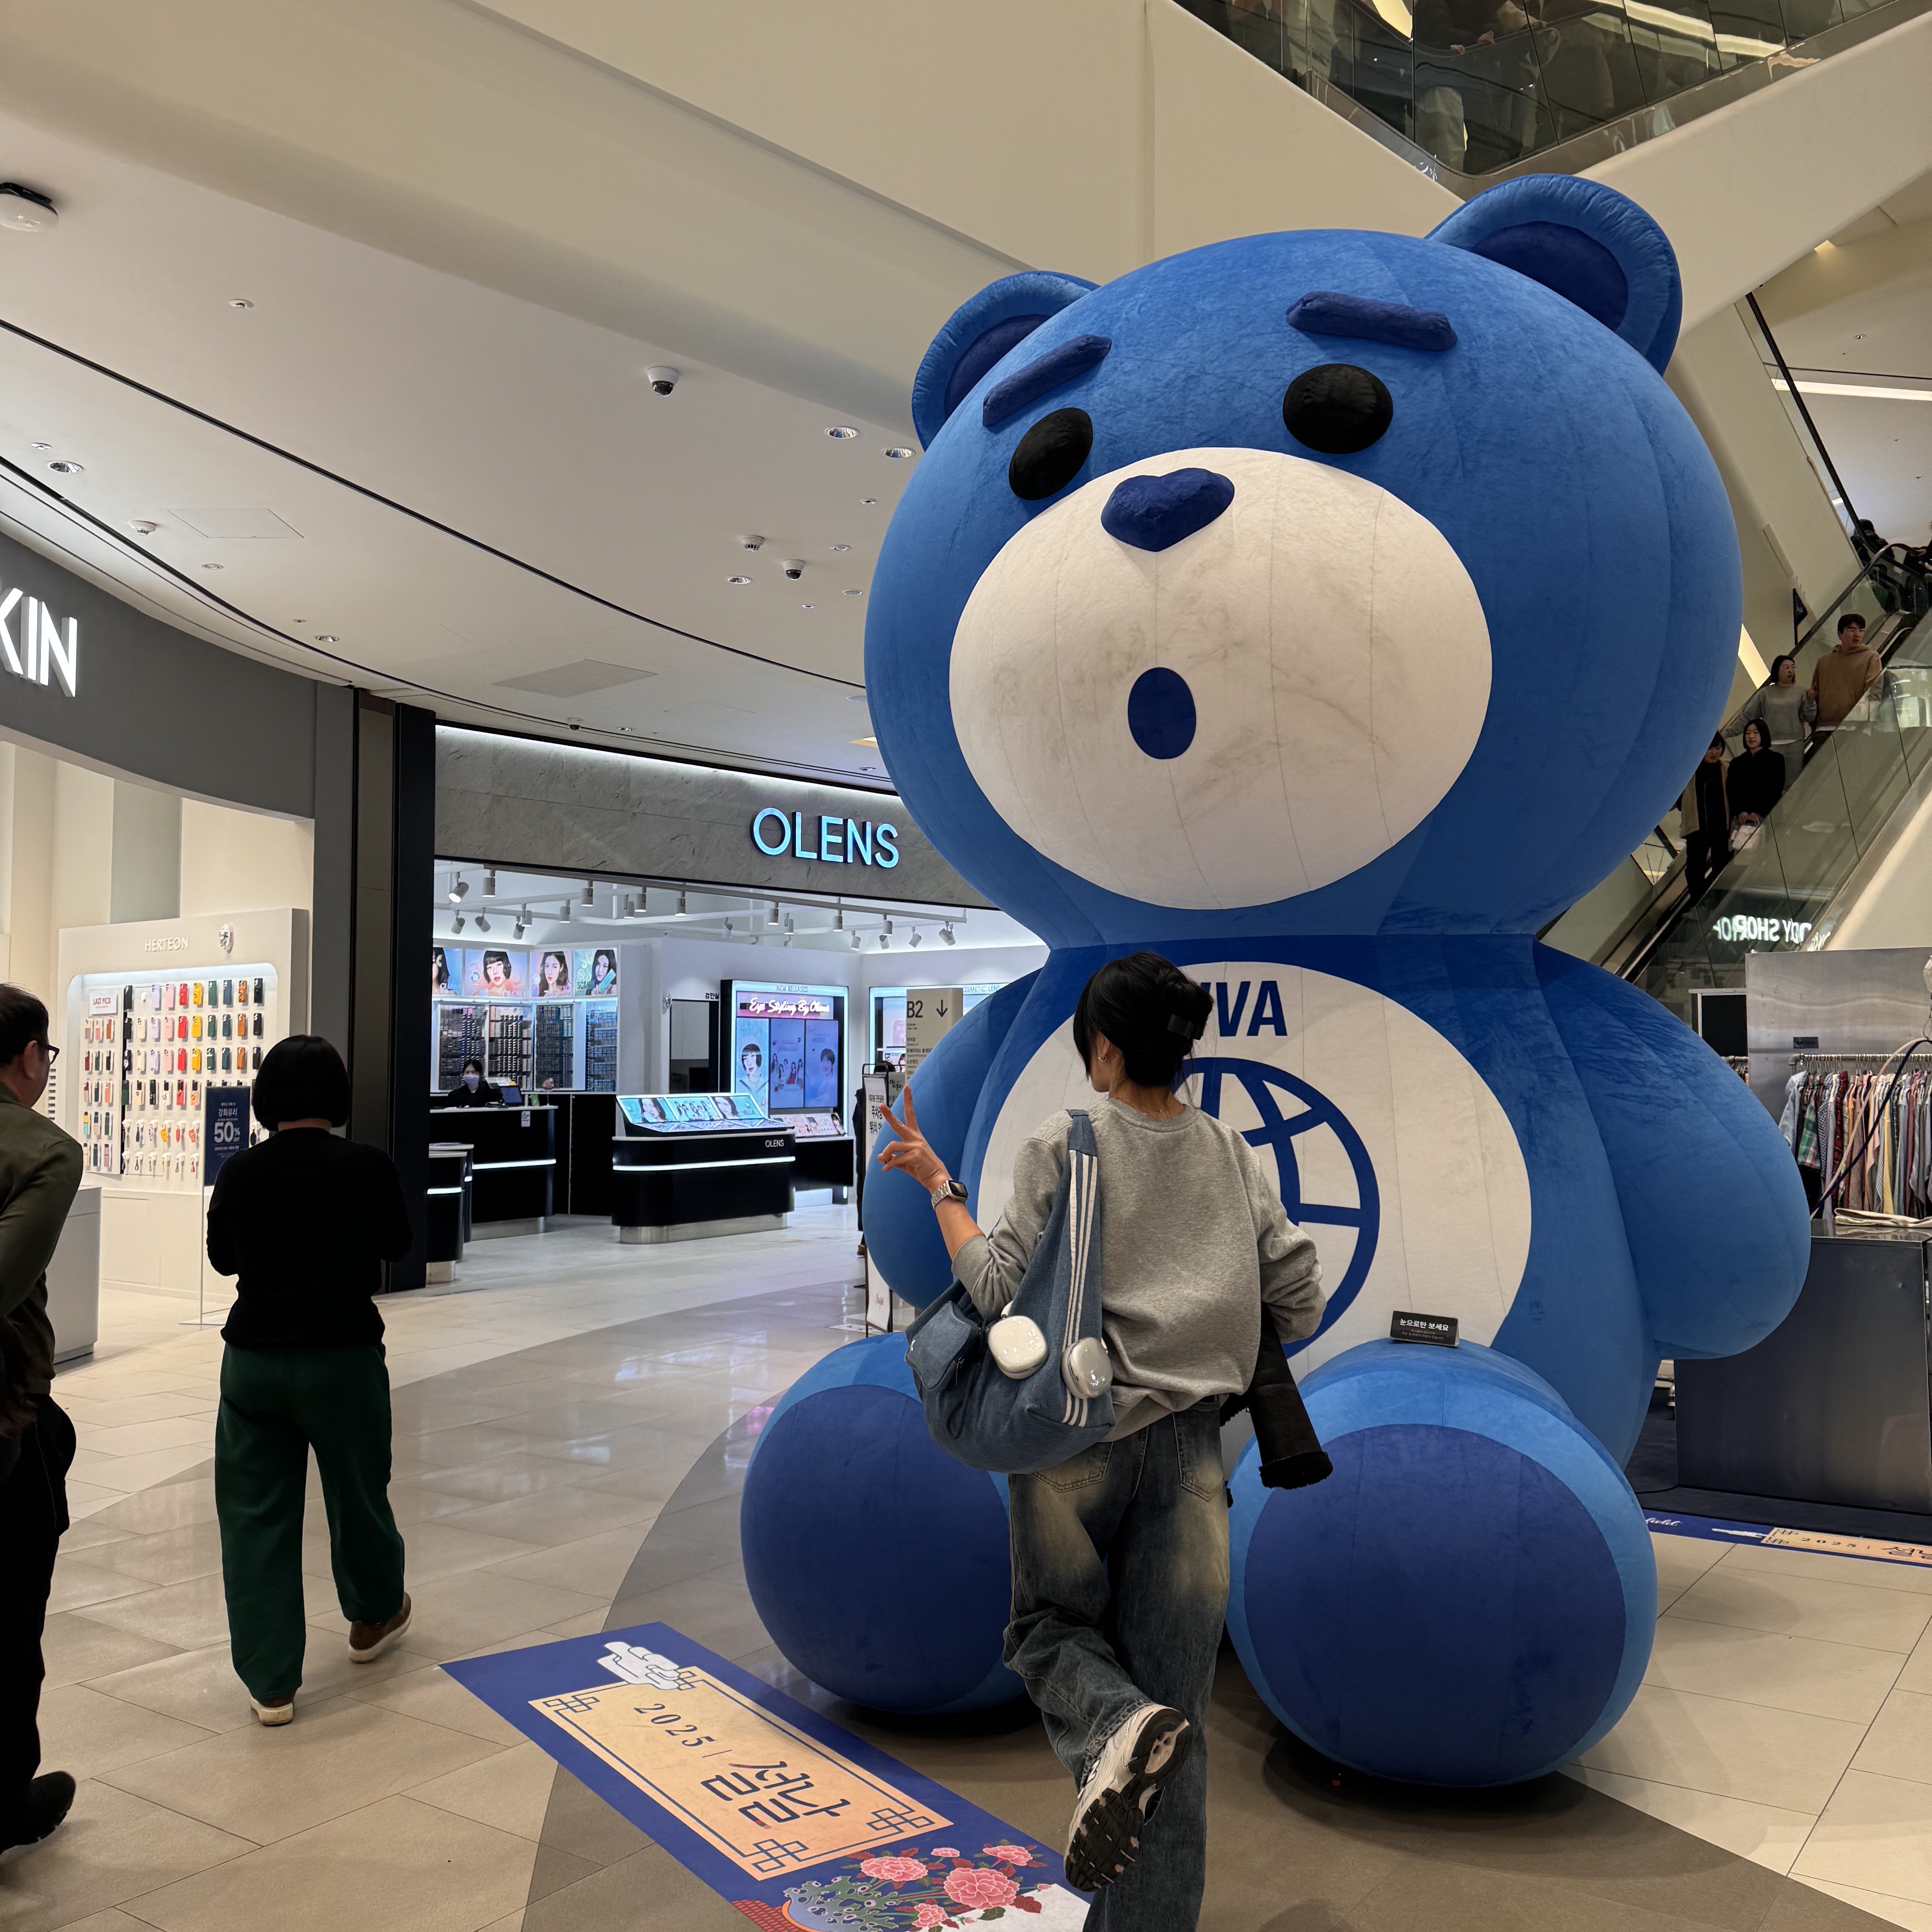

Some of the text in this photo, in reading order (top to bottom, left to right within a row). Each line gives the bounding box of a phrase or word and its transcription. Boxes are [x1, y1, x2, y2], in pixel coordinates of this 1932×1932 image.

[750, 807, 899, 868] OLENS
[145, 936, 189, 952] HERTEON
[749, 997, 766, 1014] Eye
[767, 999, 796, 1016] Styling
[797, 1000, 810, 1016] By
[906, 1000, 923, 1018] B2
[1200, 980, 1288, 1037] VA
[218, 1108, 238, 1117] 강화유리
[765, 1139, 784, 1148] OLENS
[1400, 1318, 1449, 1331] 눈으로만 보세요
[1801, 1537, 1857, 1547] 2025
[634, 1703, 851, 1829] 2025 설날
